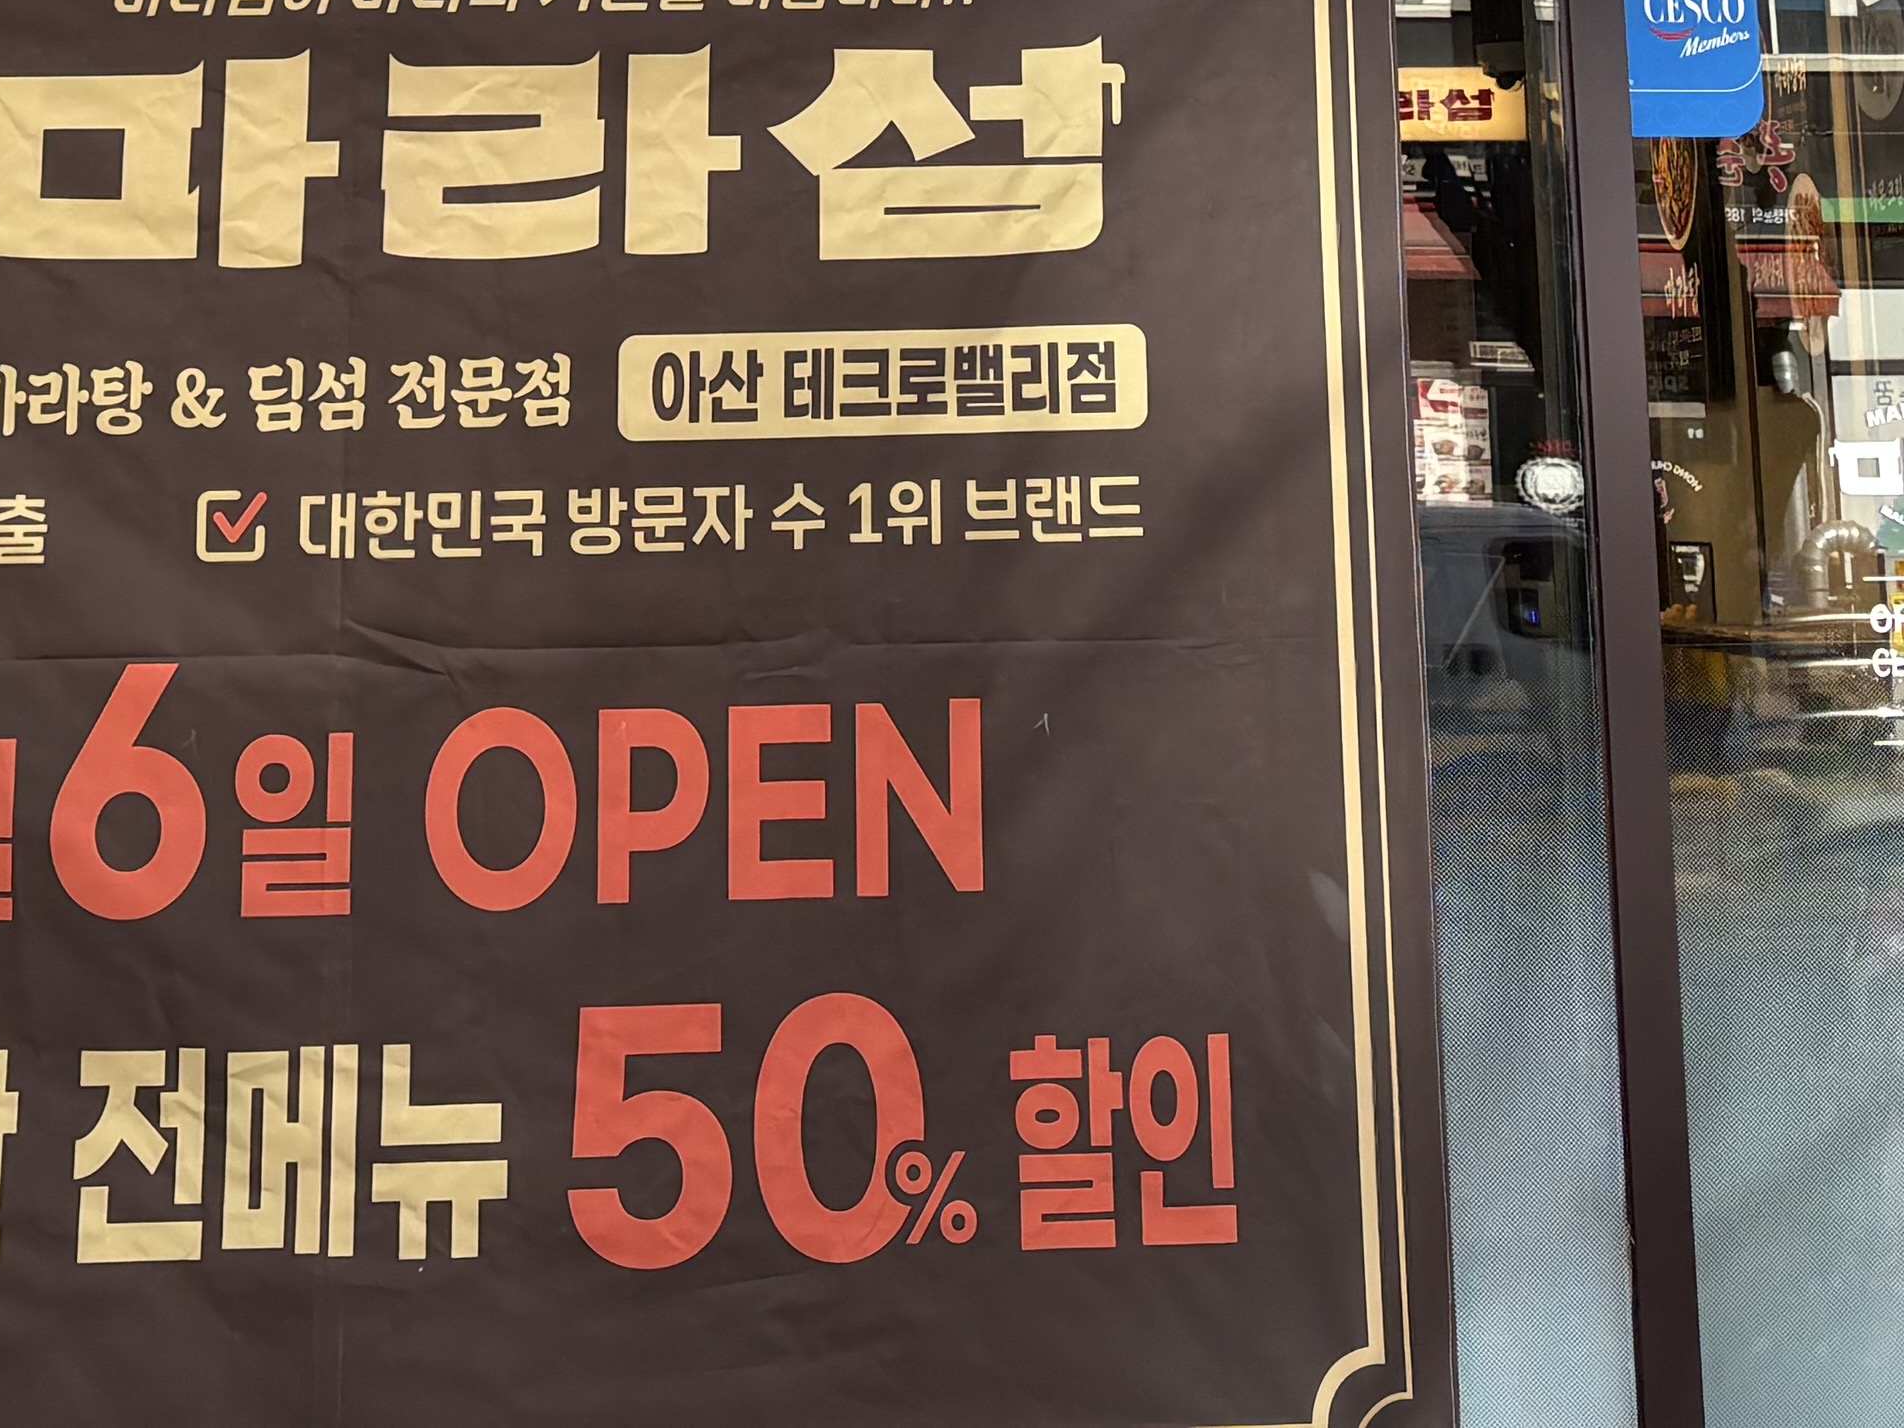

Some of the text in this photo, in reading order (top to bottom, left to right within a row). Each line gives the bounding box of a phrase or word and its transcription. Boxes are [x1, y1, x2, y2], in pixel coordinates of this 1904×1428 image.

[1679, 27, 1750, 58] Members
[169, 371, 224, 430] &
[248, 358, 369, 435] 딤섬
[388, 353, 573, 432] 전문점
[650, 339, 1118, 427] 아산 테크로밸리점
[298, 472, 1146, 561] 대한민국 방문자 수 1위 브랜드
[424, 697, 984, 912] OPEN
[72, 1043, 509, 1264] 전메뉴
[566, 992, 979, 1270] 50%
[1009, 1032, 1239, 1252] 할인
